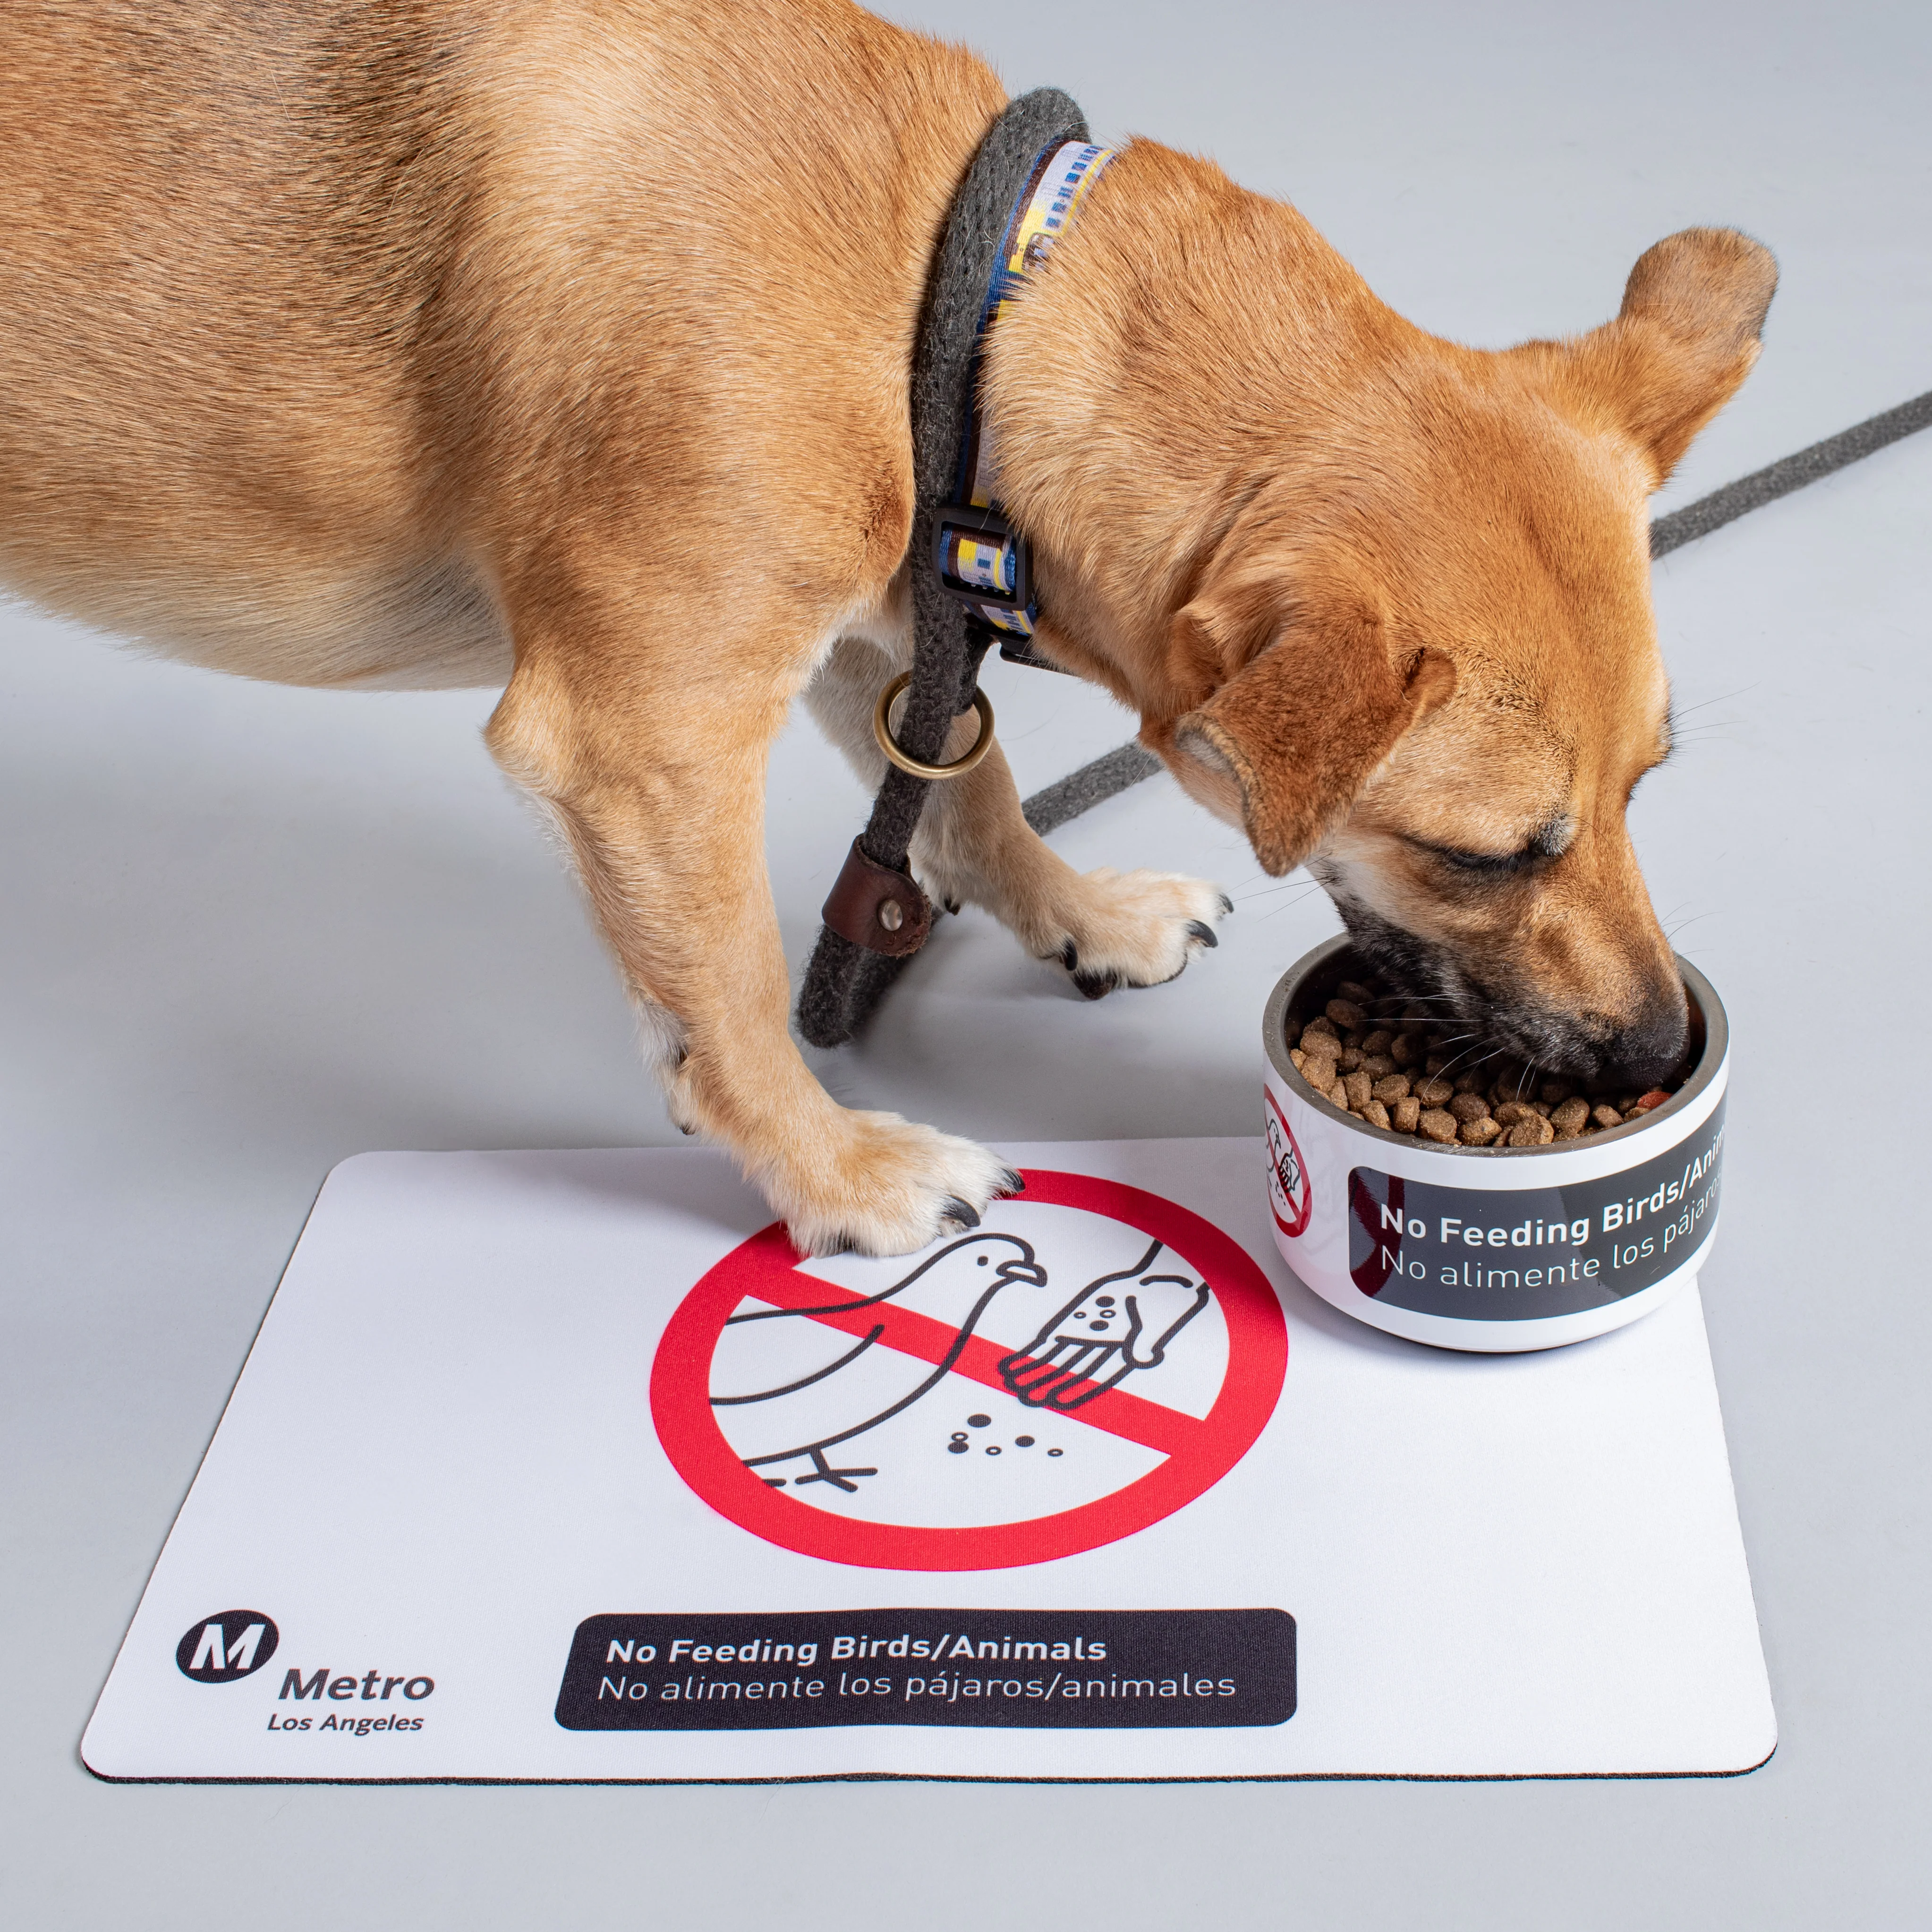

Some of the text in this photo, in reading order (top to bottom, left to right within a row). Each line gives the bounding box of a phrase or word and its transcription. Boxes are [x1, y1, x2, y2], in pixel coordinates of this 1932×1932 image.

[1381, 1203, 1426, 1239] No
[1440, 1217, 1591, 1248] Feeding
[1382, 1245, 1426, 1280] No
[1440, 1257, 1600, 1288] alimente
[1613, 1236, 1655, 1269] los
[188, 1623, 266, 1670] M
[606, 1634, 1107, 1667] No Feeding Birds/Animals
[278, 1668, 435, 1701] Metro
[598, 1670, 1236, 1703] No alimente los pájaros/animales
[267, 1713, 424, 1736] Los Angeles
